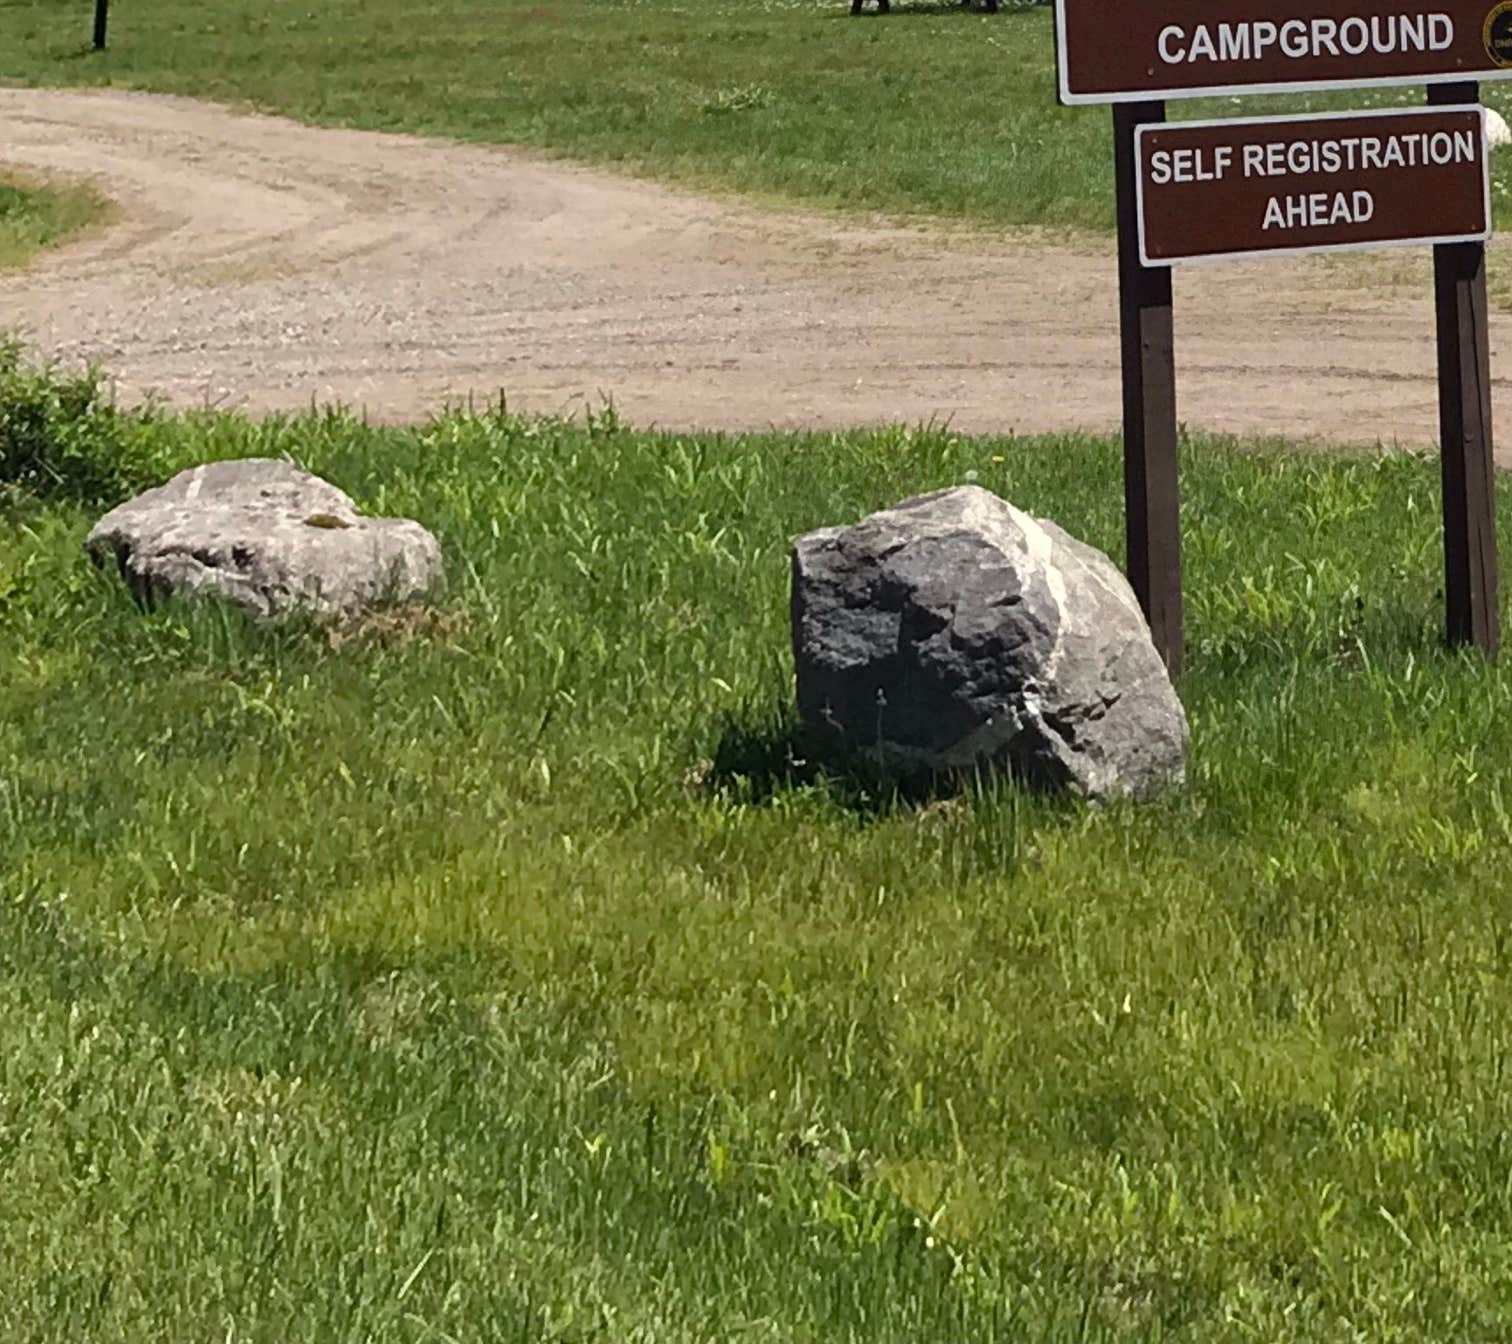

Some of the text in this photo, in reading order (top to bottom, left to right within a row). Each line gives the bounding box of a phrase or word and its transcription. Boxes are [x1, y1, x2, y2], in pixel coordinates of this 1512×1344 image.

[1159, 14, 1453, 63] CAMPGROUND
[1152, 131, 1474, 183] SELF REGISTRATION
[1263, 191, 1373, 229] AHEAD
